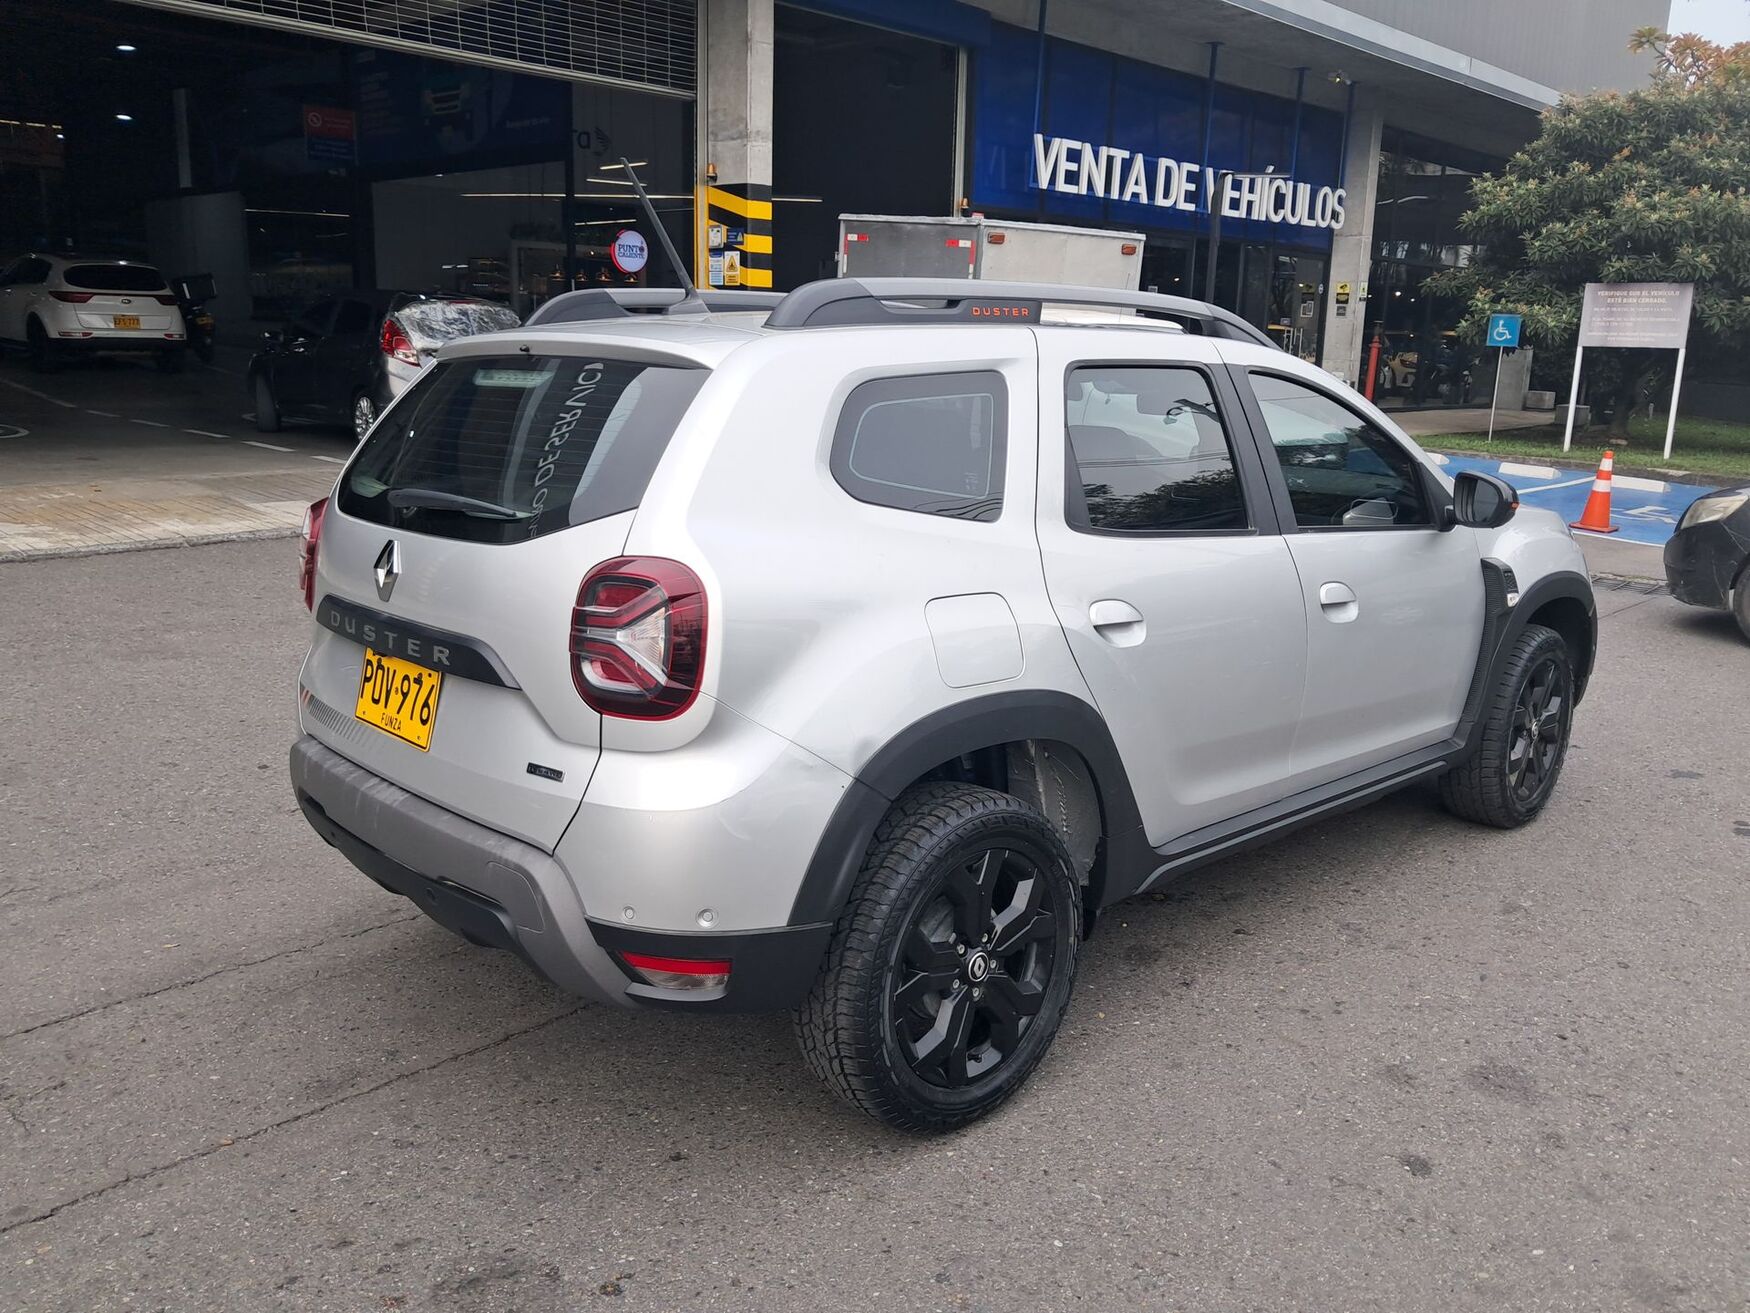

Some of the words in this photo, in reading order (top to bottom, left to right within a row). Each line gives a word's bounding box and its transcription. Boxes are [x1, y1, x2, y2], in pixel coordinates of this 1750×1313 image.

[1034, 133, 1148, 204] VENTA
[1154, 157, 1200, 211] DE
[971, 306, 1030, 317] DUSTER
[330, 610, 451, 666] DUSTER
[380, 712, 402, 731] FUNZA
